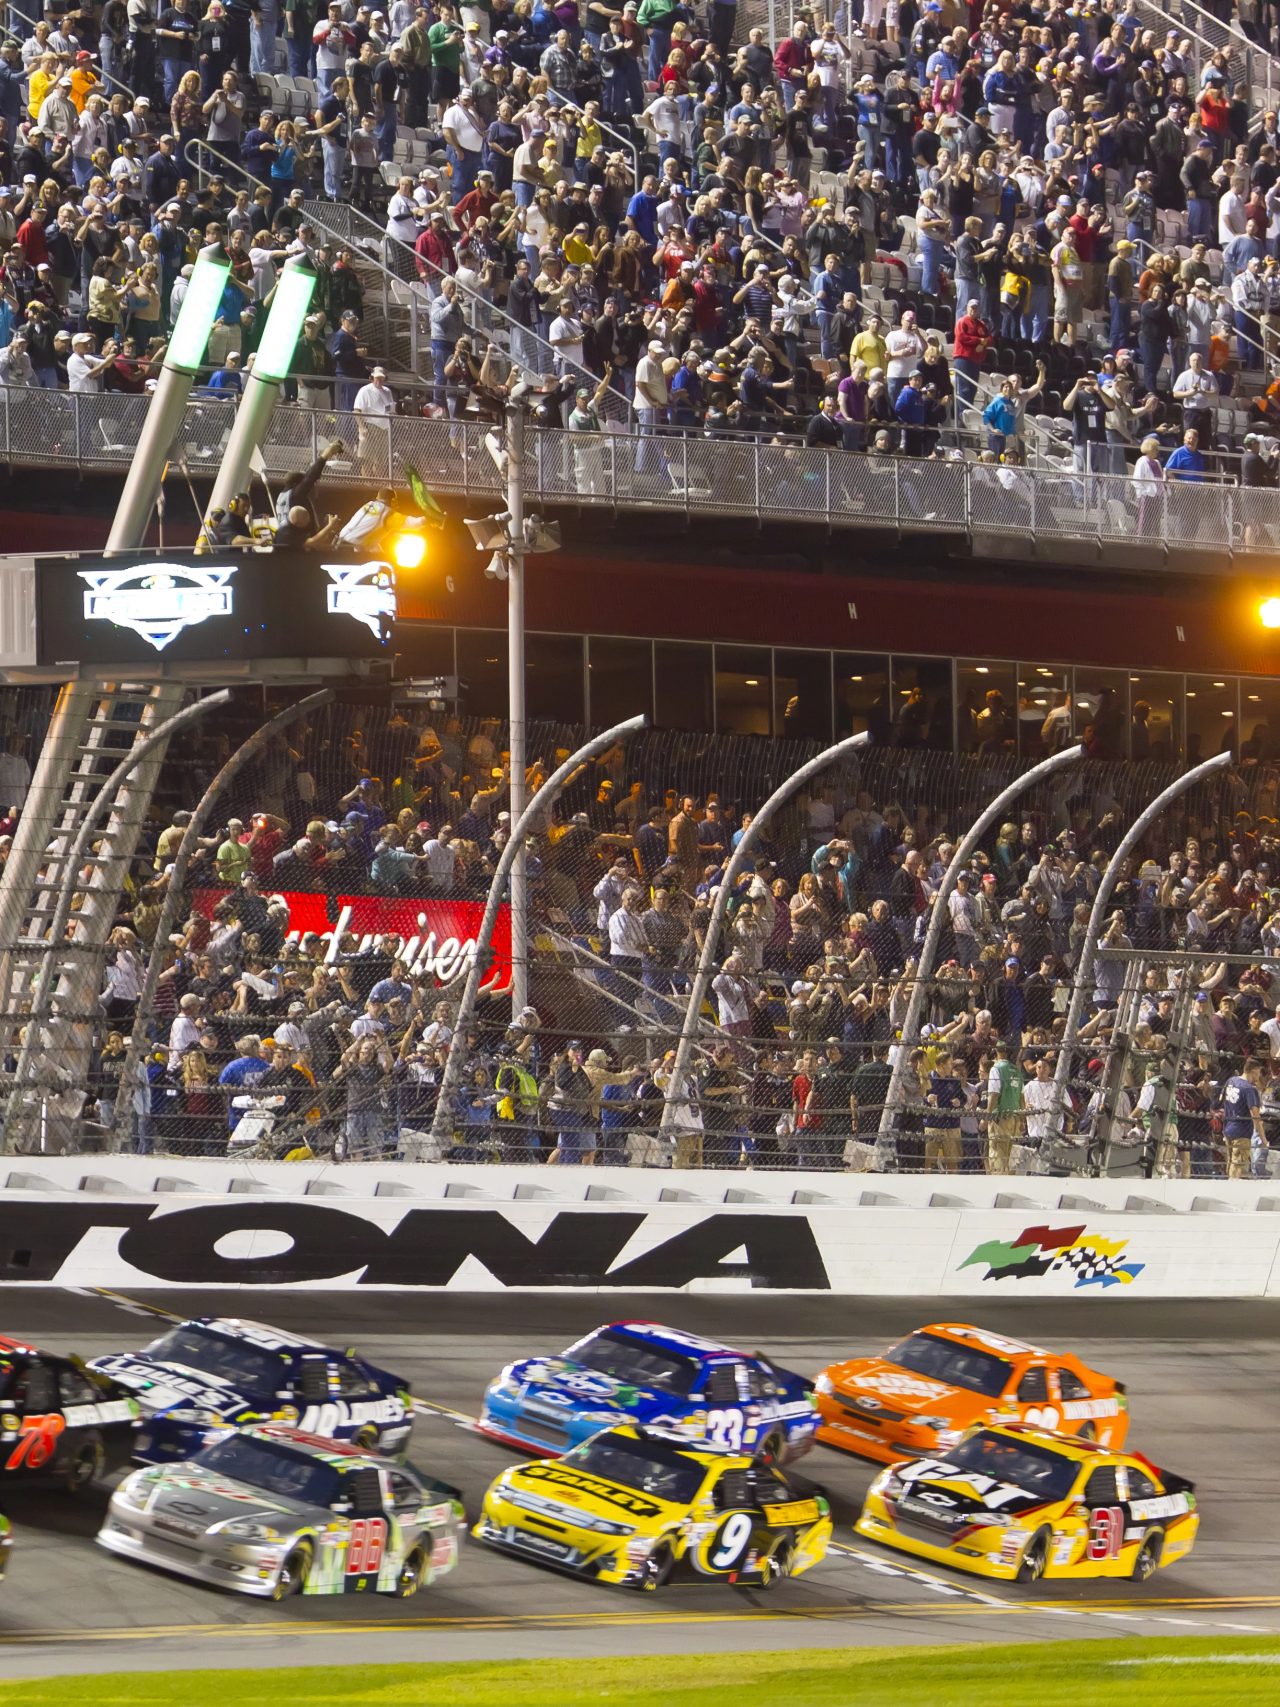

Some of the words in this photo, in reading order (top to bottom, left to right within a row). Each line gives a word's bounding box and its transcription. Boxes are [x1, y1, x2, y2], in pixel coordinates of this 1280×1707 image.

[445, 575, 455, 593] G
[847, 602, 858, 620] H
[1175, 625, 1185, 642] H
[707, 1408, 744, 1450] 33
[525, 1466, 660, 1512] STANLEY
[897, 1458, 1040, 1509] CAT
[344, 1517, 388, 1576] 88
[712, 1513, 752, 1567] 9
[1087, 1506, 1124, 1560] 31
